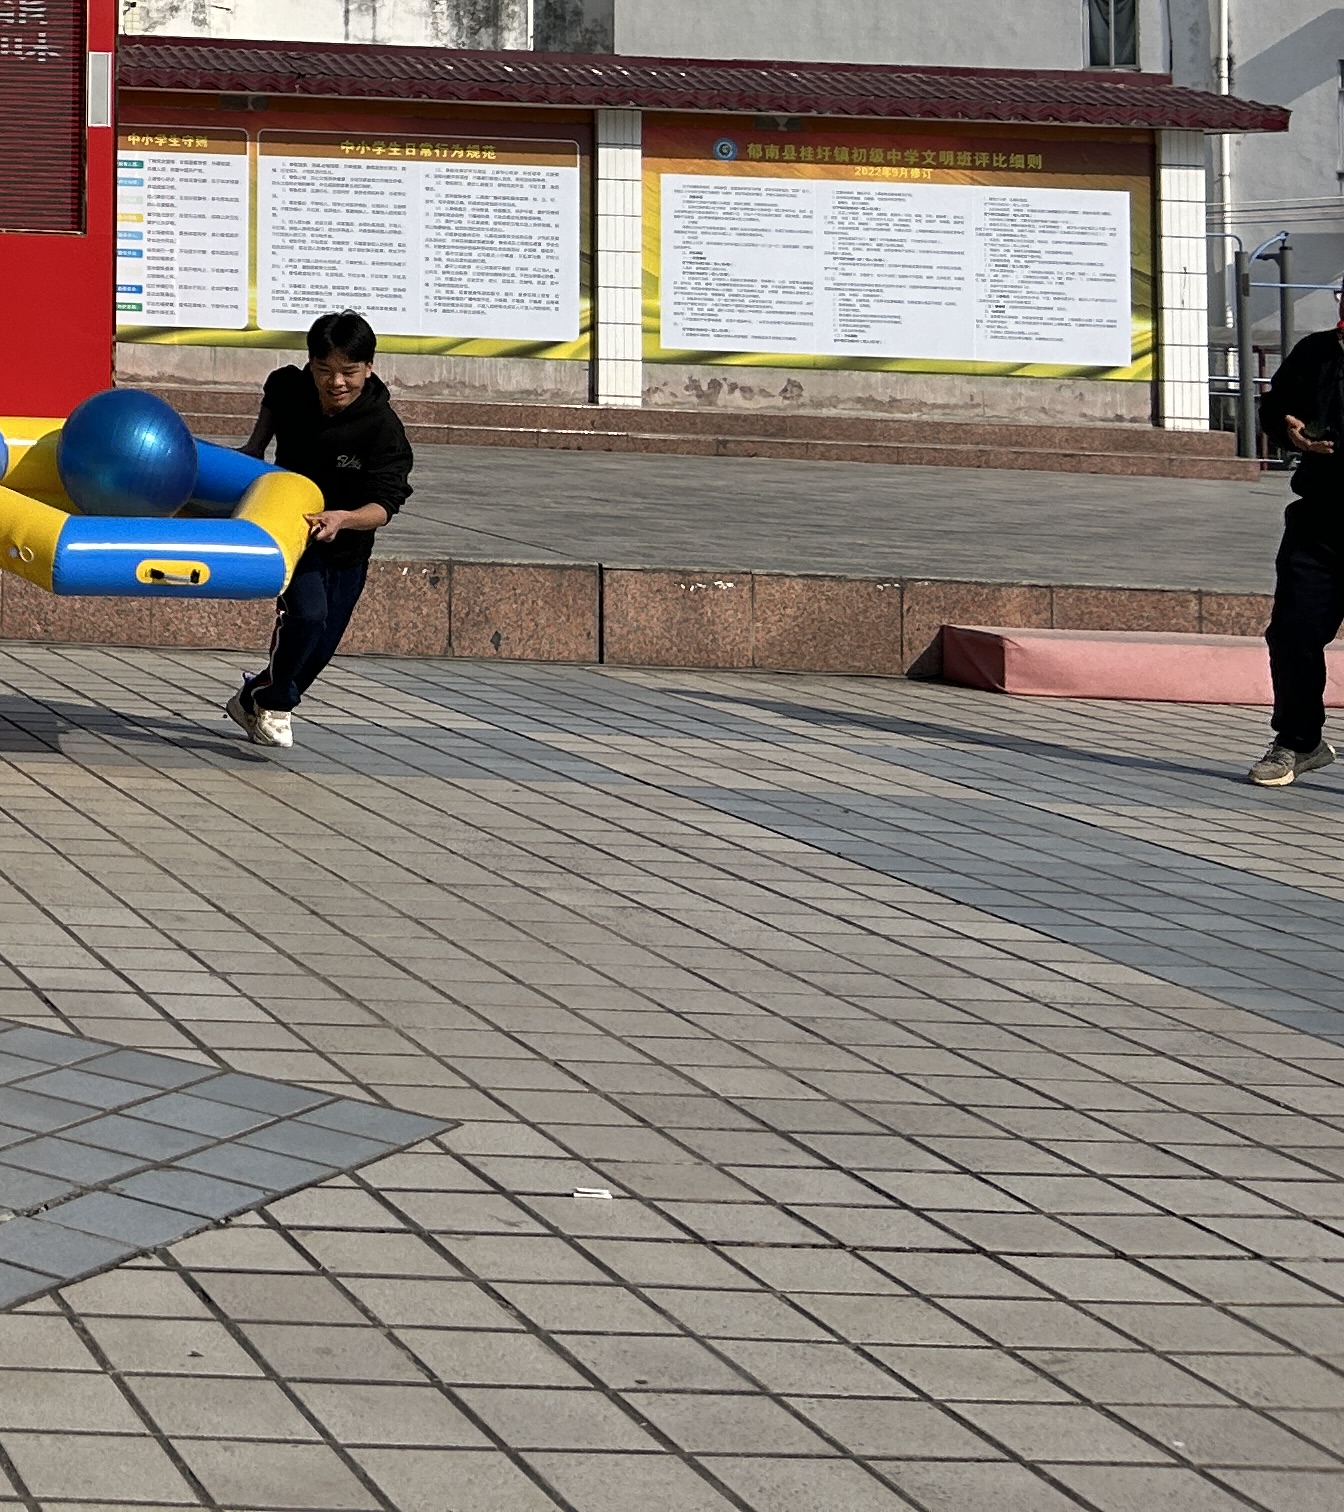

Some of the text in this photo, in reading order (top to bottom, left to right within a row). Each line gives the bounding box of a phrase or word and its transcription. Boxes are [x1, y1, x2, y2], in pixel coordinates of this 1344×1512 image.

[126, 132, 209, 149] 中小学生守则
[340, 140, 497, 160] 中小学生日常行为规范
[746, 143, 1043, 170] 郁南县桂圩镇初级中学文明班评比细则
[853, 165, 933, 180] 2022年9月修订
